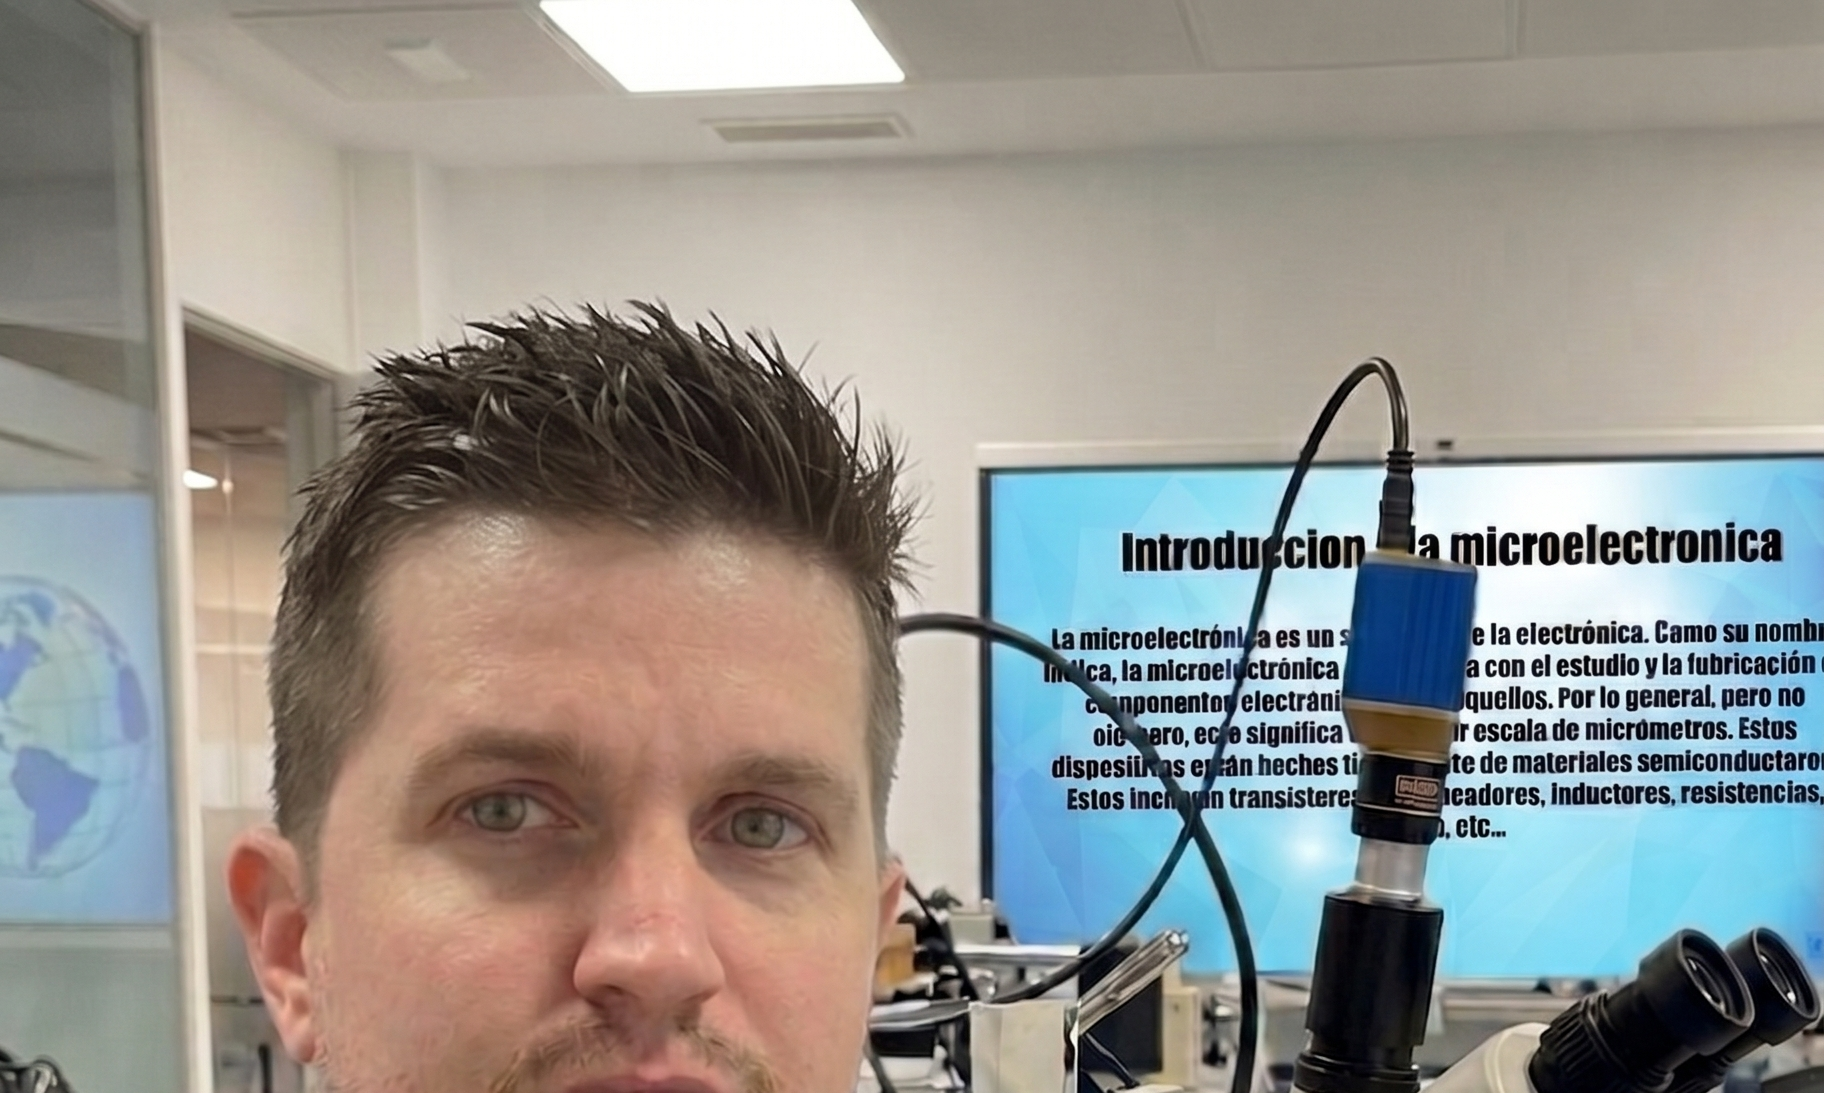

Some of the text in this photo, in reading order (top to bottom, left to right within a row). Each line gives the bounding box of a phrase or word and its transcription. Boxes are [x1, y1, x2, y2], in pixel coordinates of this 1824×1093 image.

[1122, 529, 1366, 572] Introduccion
[1450, 522, 1783, 567] microelectronica
[1052, 628, 1074, 650] La
[1080, 624, 1271, 650] microelectrónia
[1276, 629, 1300, 648] es
[1307, 629, 1334, 648] un
[1491, 623, 1511, 645] la
[1516, 619, 1650, 646] electrónica.
[1655, 619, 1717, 644] Camo
[1723, 624, 1749, 643] su
[1122, 659, 1142, 682] la
[1485, 659, 1525, 678] con
[1532, 654, 1551, 678] el
[1556, 653, 1640, 678] estudio
[1645, 658, 1658, 680] y
[1663, 653, 1683, 676] la
[1460, 686, 1554, 714] quellos.
[1558, 688, 1596, 709] Por
[1600, 685, 1620, 709] lo
[1625, 684, 1716, 712] general,
[1721, 687, 1772, 711] pero
[1778, 686, 1806, 708] no
[1246, 720, 1343, 748] significa
[1474, 719, 1548, 743] escala
[1552, 718, 1580, 742] de
[1585, 717, 1734, 741] micrómetros.
[1258, 753, 1339, 777] heches
[1480, 750, 1508, 774] de
[1513, 750, 1633, 774] materiales
[1637, 749, 1824, 773] semiconductaro
[1067, 788, 1125, 811] Estos
[1551, 782, 1676, 808] inductores,
[1681, 780, 1824, 806] resistencias,
[1456, 815, 1507, 839] etc...
